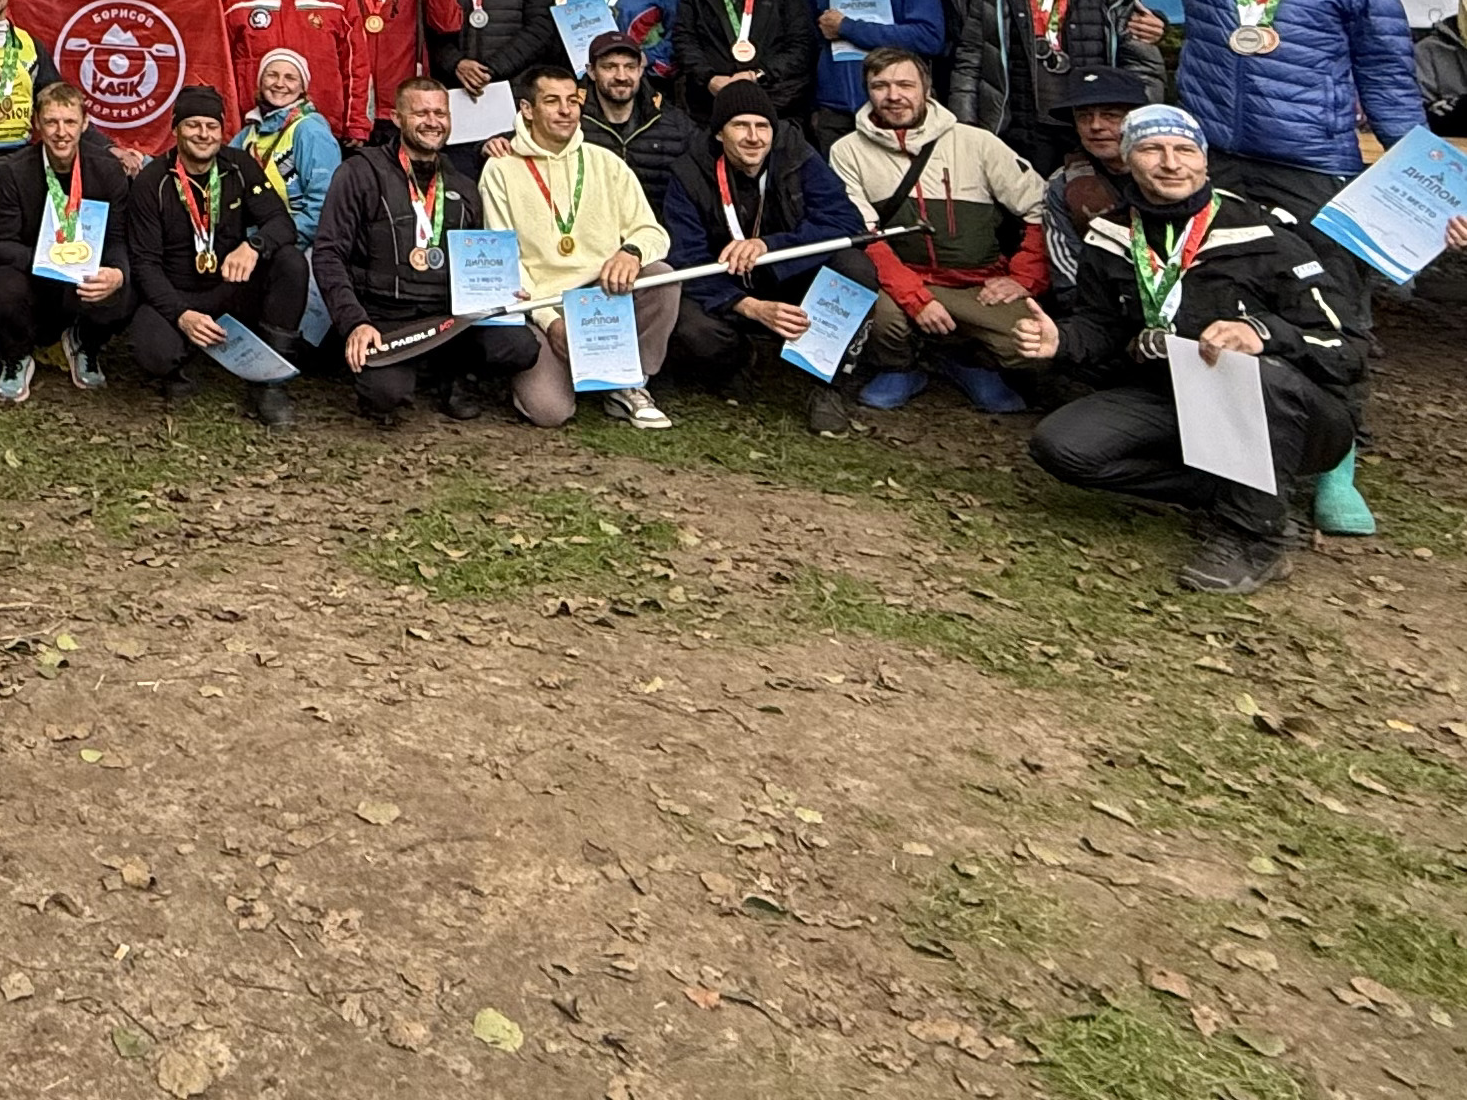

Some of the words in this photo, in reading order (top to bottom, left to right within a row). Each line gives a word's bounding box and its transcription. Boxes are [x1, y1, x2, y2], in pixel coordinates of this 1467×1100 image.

[92, 8, 155, 29] БОРИСОВ
[84, 96, 156, 118] ПОРТКЛУБ
[1402, 166, 1461, 208] ДИПЛОМ
